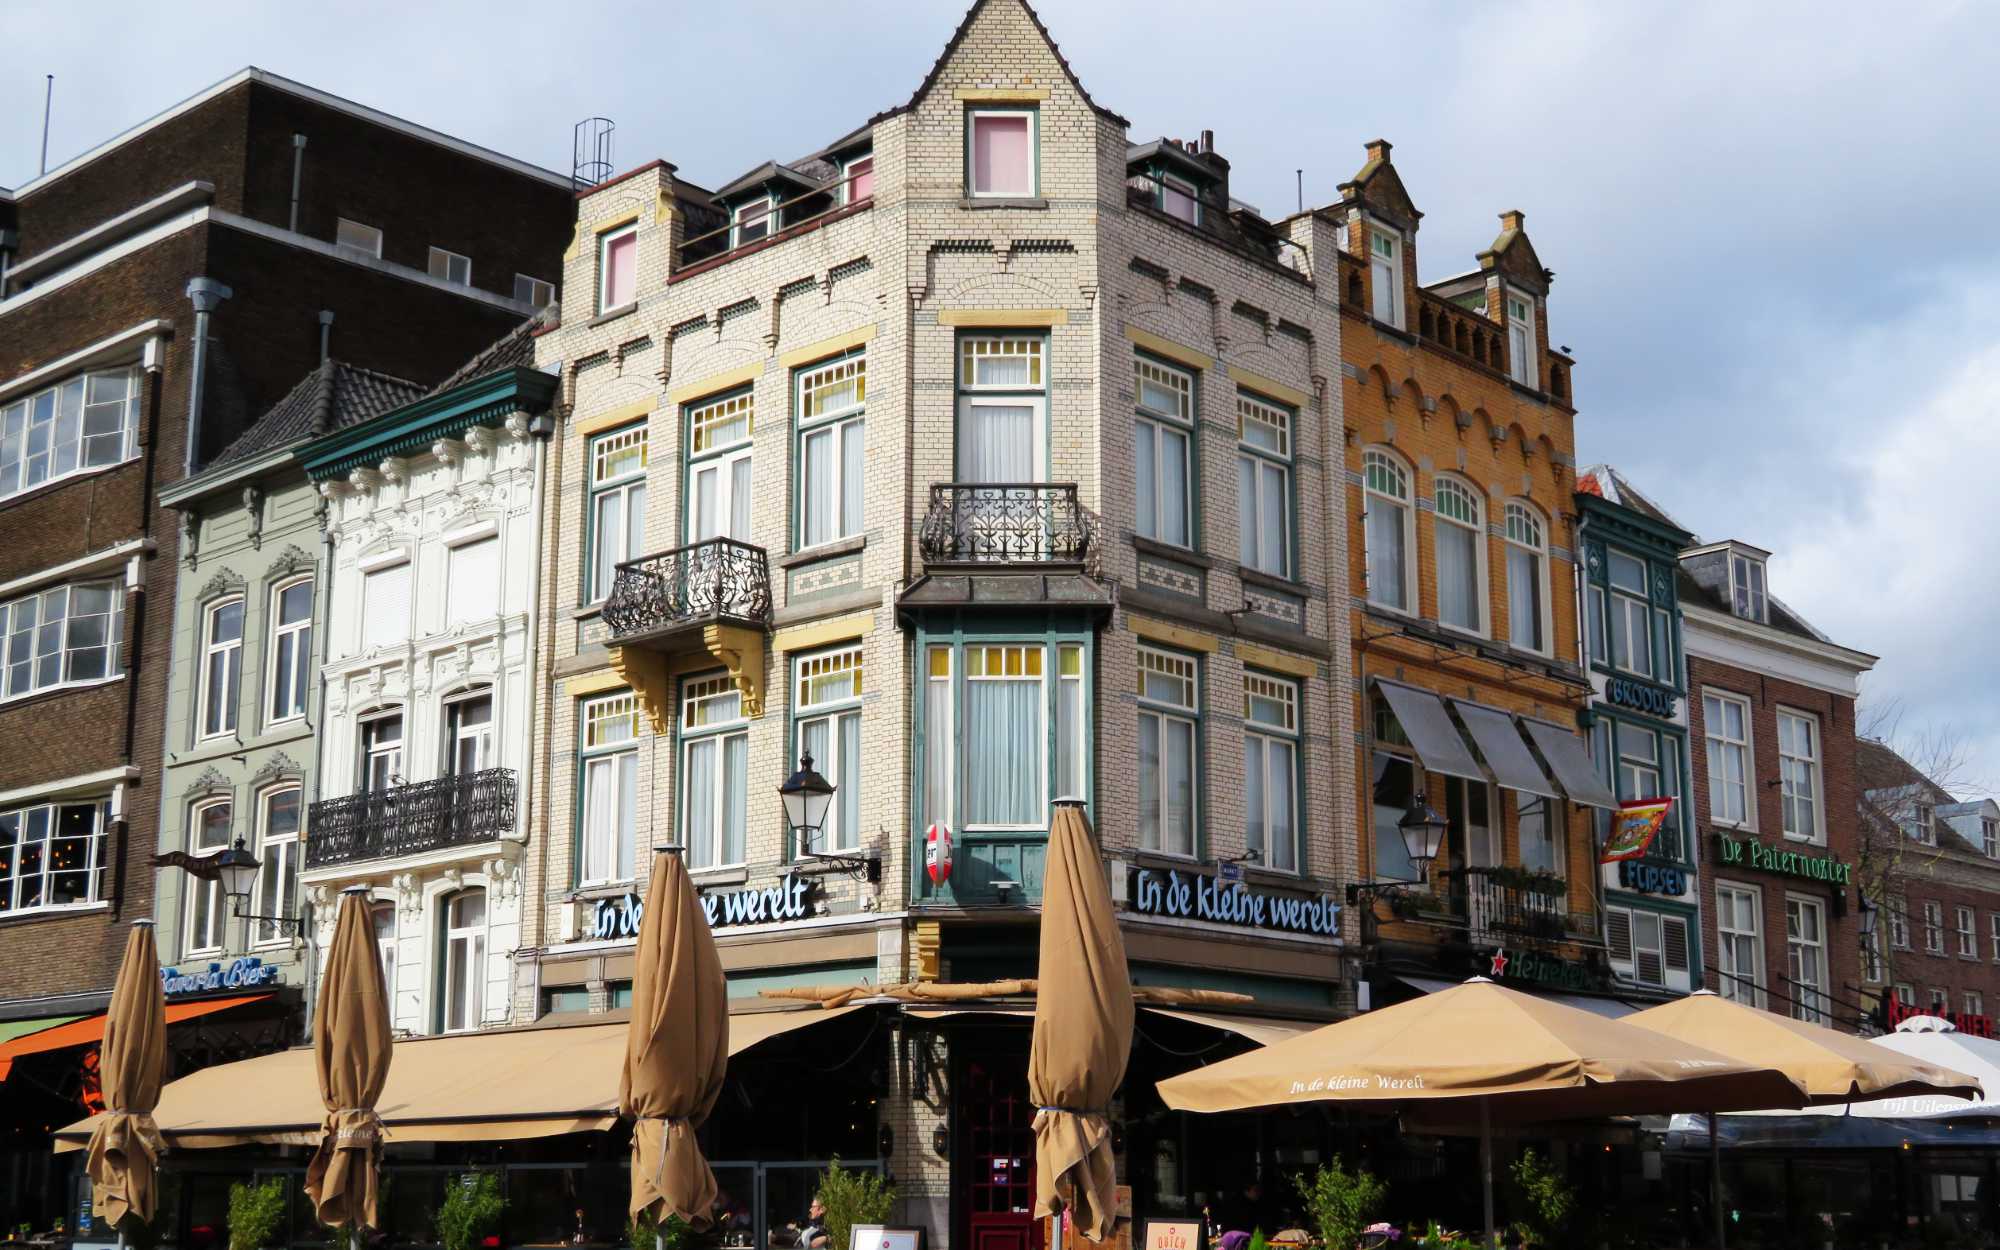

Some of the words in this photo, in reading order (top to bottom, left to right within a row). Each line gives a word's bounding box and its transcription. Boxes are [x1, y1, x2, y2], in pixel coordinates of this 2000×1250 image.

[1626, 861, 1687, 896] FLIPSEN
[1720, 832, 1743, 862] De
[1750, 837, 1852, 885] Paternoster
[620, 893, 642, 934] de
[724, 873, 809, 925] werelt
[1137, 870, 1161, 913] In
[1166, 869, 1192, 916] de
[1197, 874, 1266, 925] kleine
[1270, 895, 1342, 935] werelt
[223, 957, 276, 986] Bier
[1290, 1081, 1305, 1094] In
[1308, 1077, 1323, 1091] de
[1327, 1075, 1369, 1090] kleine
